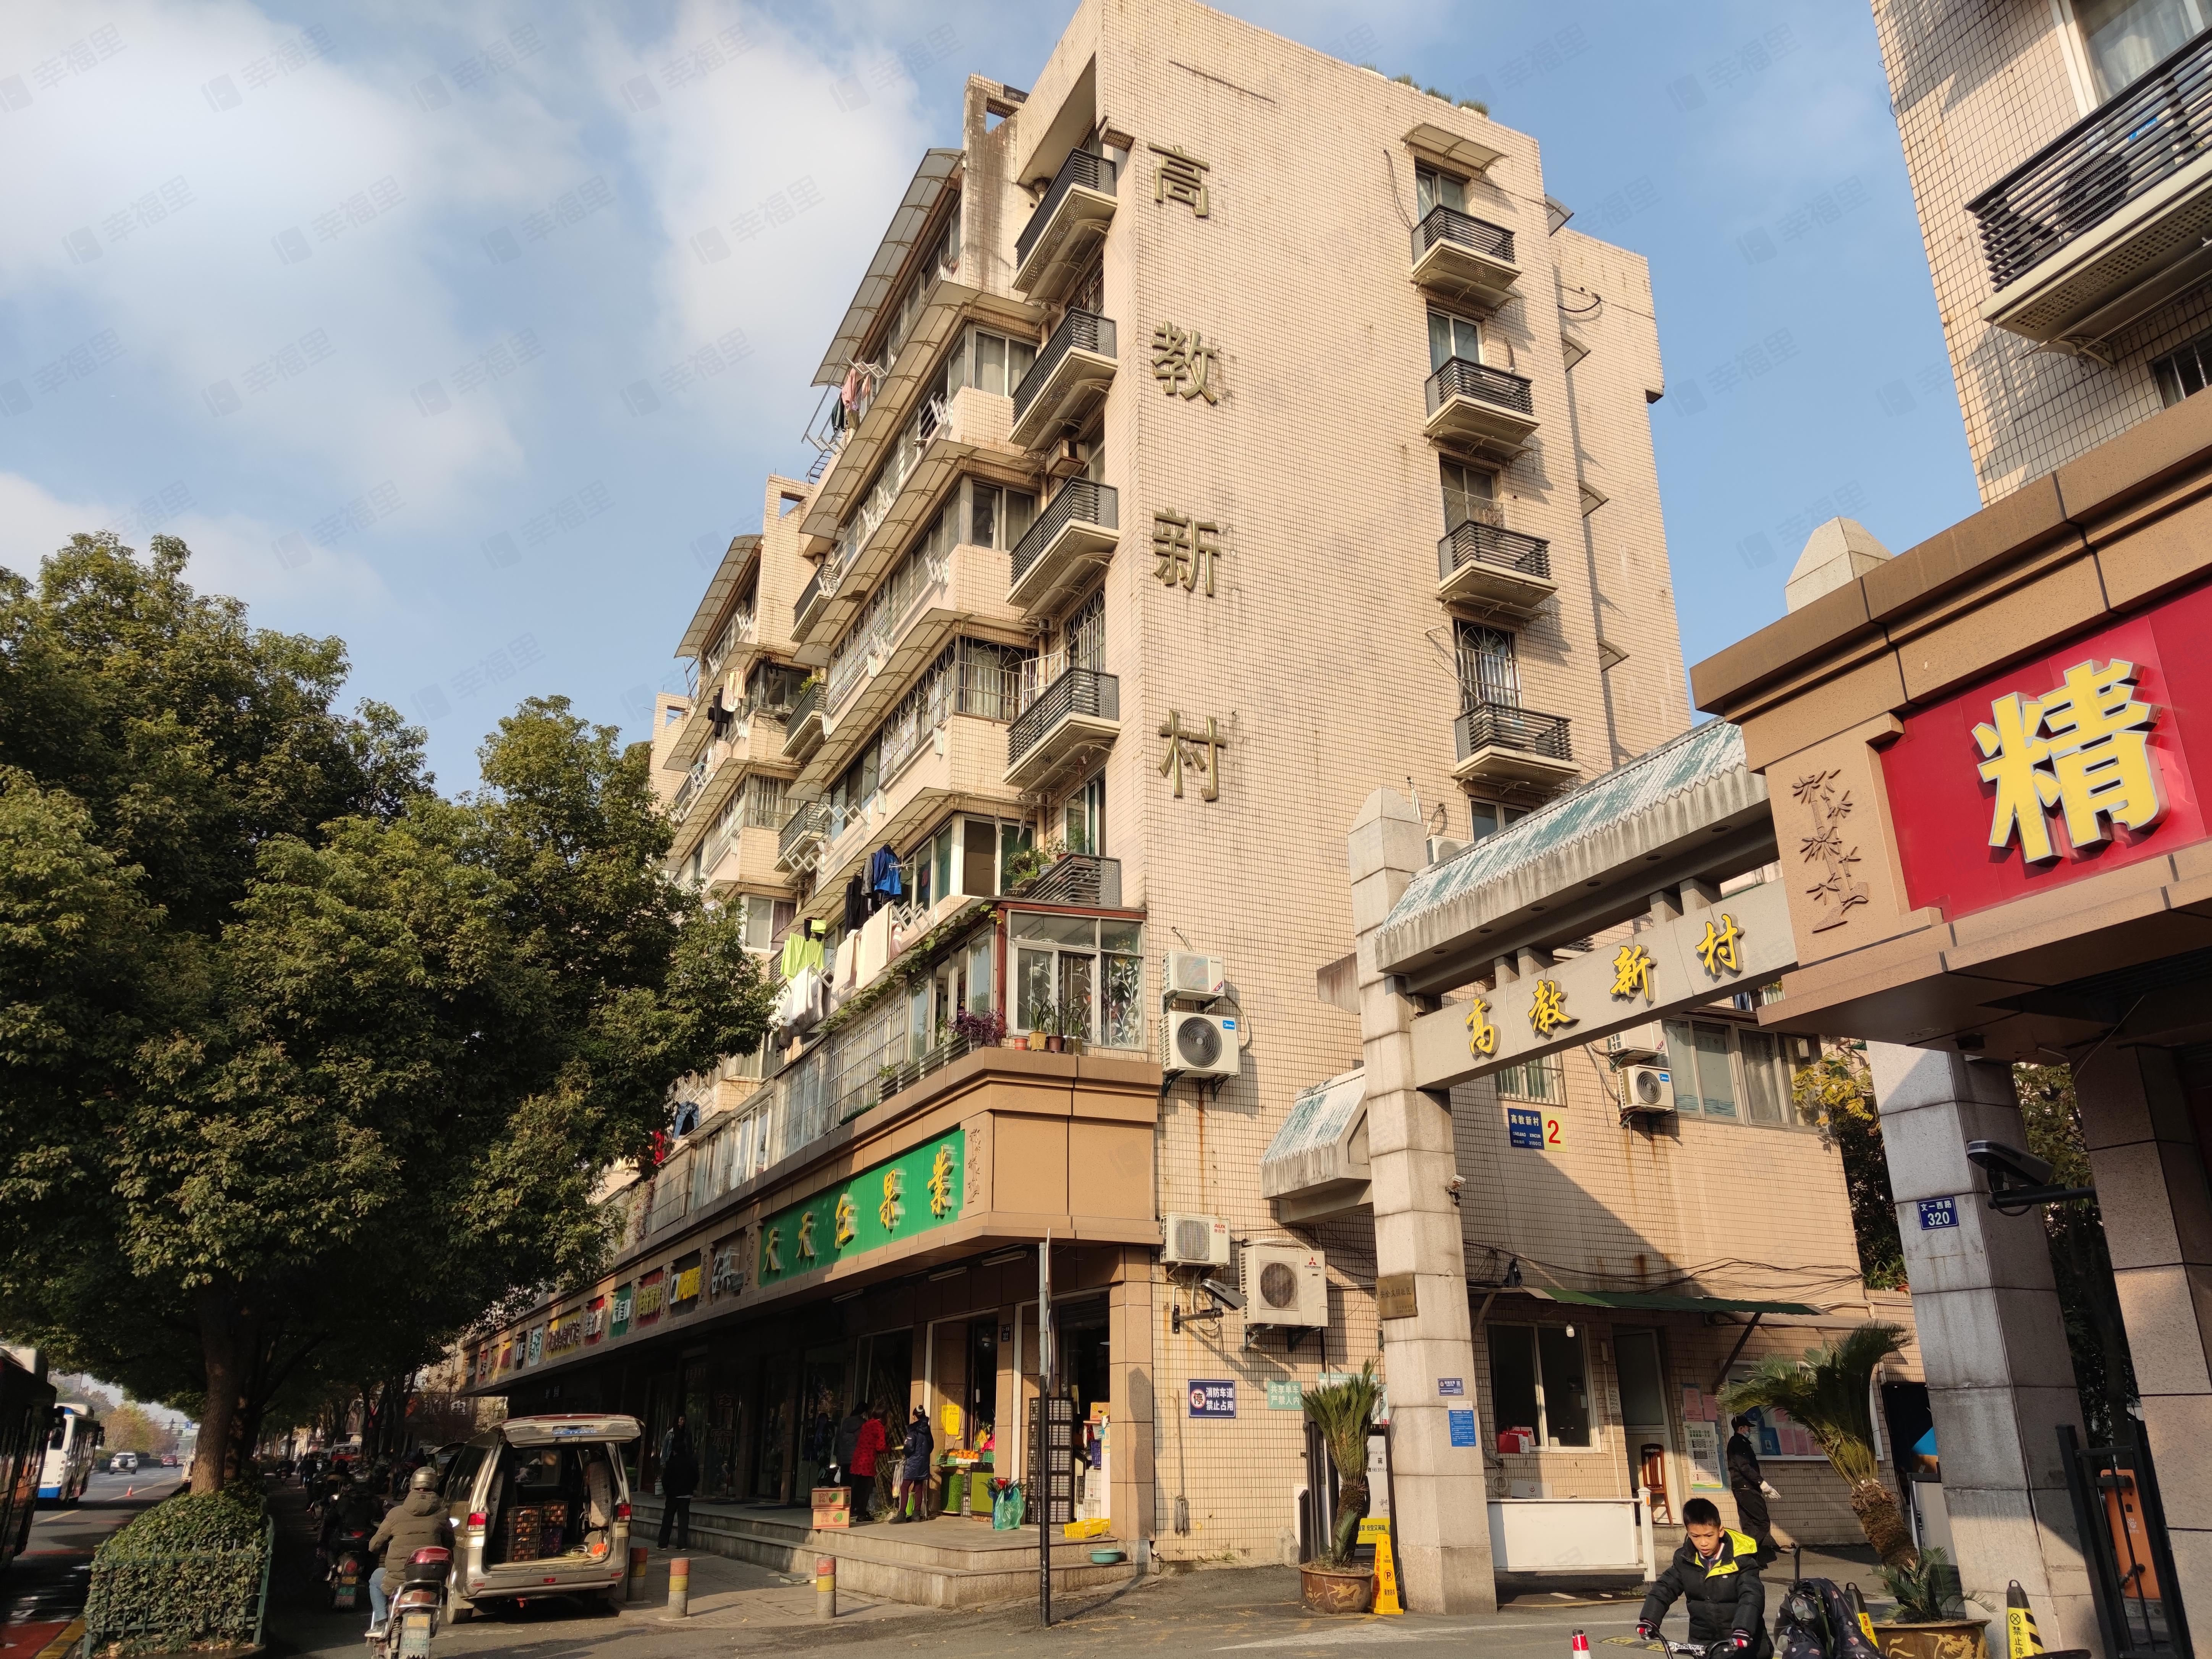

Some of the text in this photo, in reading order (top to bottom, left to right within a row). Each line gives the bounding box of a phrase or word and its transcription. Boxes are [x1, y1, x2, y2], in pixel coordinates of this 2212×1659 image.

[1147, 142, 1226, 802] 高教新村
[1971, 658, 2162, 863] 精
[1465, 913, 1742, 1056] 高教新村
[1511, 1114, 1539, 1126] 高教新村
[1547, 1120, 1561, 1144] 2
[1920, 1200, 1952, 1212] 文一西路
[1927, 1211, 1950, 1226] 320
[1380, 1287, 1412, 1298] 安全文明社区
[1206, 1387, 1234, 1398] 消防车道
[1271, 1385, 1300, 1394] 共享单车
[1206, 1400, 1234, 1411] 禁止占用
[1271, 1395, 1300, 1405] 严禁入内
[2011, 1626, 2024, 1659] 禁止停
